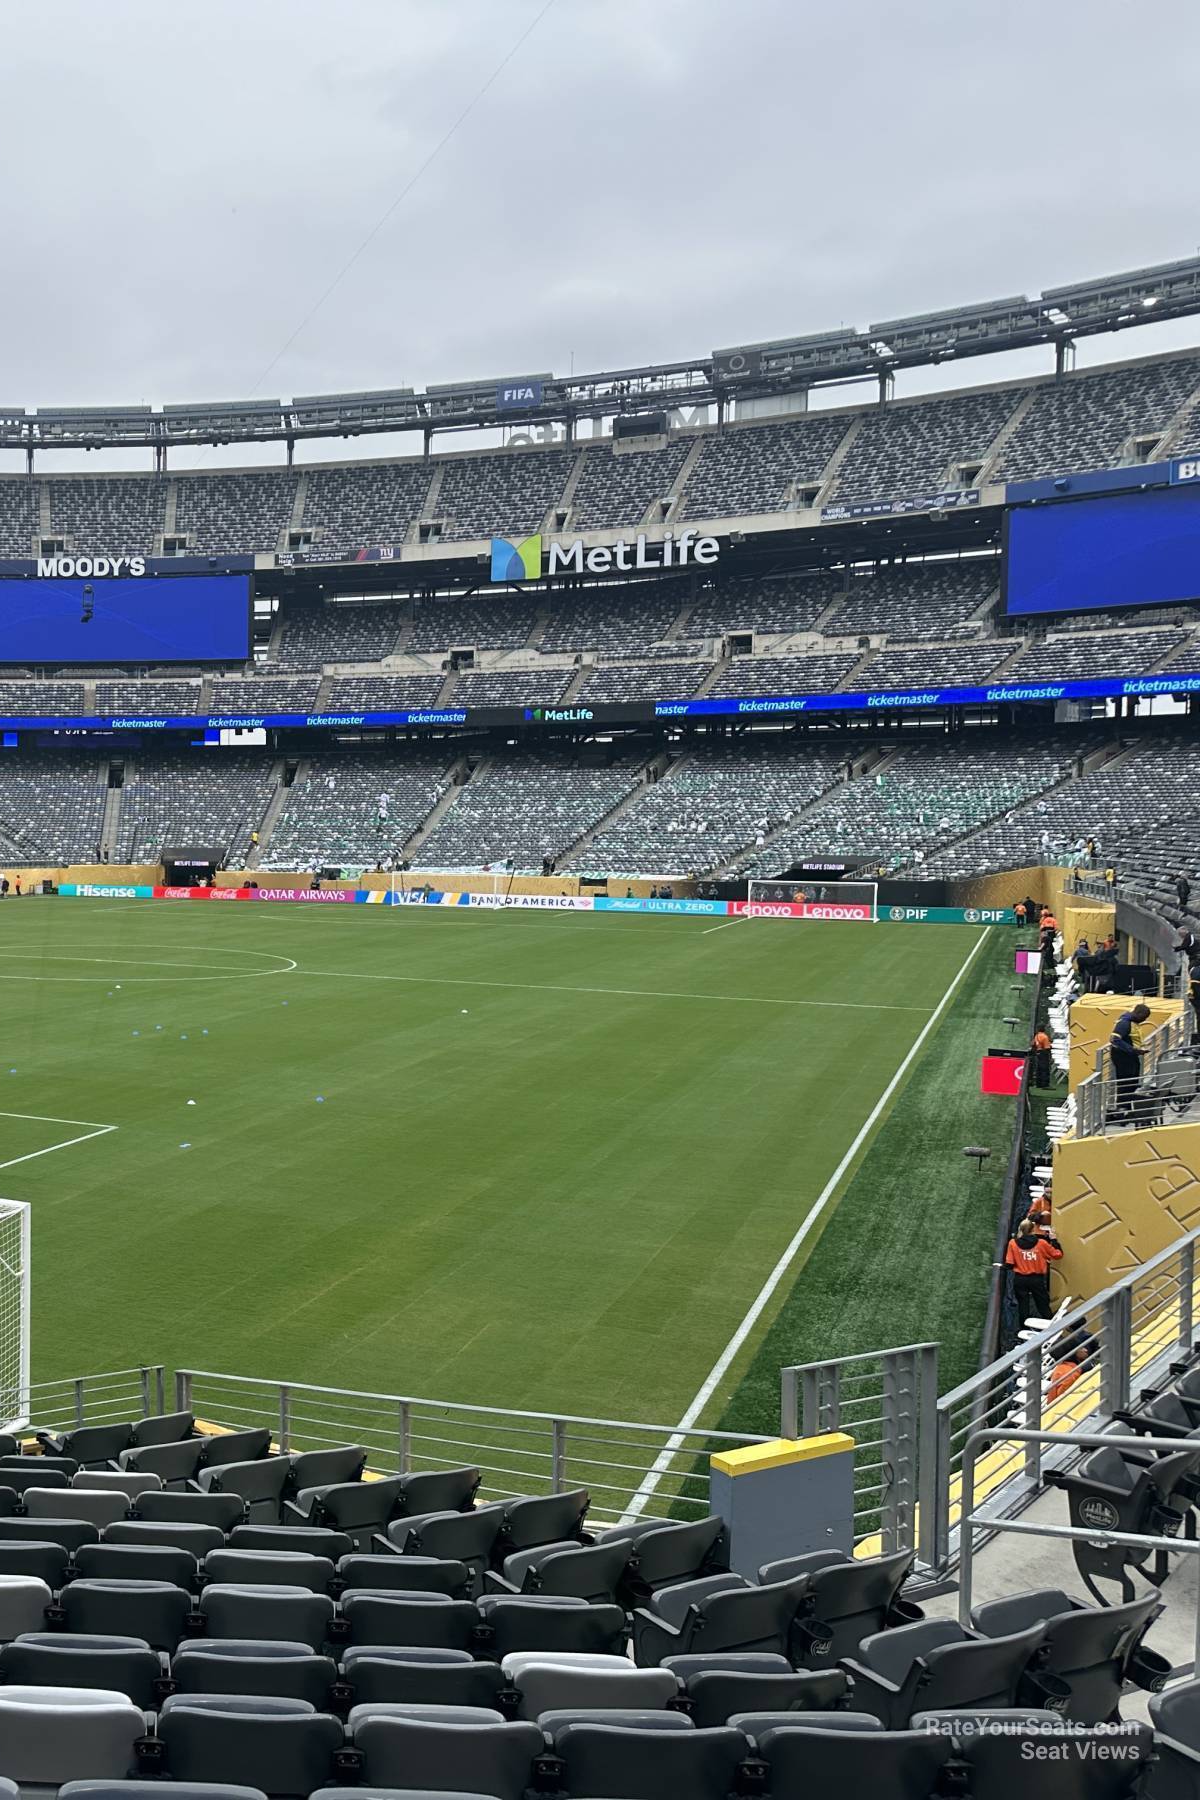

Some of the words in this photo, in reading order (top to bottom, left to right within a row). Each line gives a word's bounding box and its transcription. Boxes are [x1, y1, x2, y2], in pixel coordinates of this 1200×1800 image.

[504, 388, 534, 400] FIFA
[549, 528, 720, 575] MetLife
[37, 557, 145, 577] MOODY'S
[867, 692, 940, 706] ticketmaster
[986, 686, 1064, 700] ticketmaster
[738, 699, 806, 711] ticketmaster
[306, 715, 364, 726] ticketmaster
[544, 709, 594, 721] MetLife
[111, 719, 167, 728] ticketmaster
[208, 717, 264, 727] ticketmaster
[76, 885, 136, 898] Hisense
[259, 889, 294, 900] QATAR
[299, 889, 345, 900] AIRWAYS
[471, 895, 502, 905] BANK
[505, 897, 519, 905] OF
[522, 897, 575, 907] AMERICA
[649, 902, 681, 910] ULTRA
[685, 902, 714, 912] ZERO
[733, 903, 792, 917] Lenovo
[802, 904, 864, 918] Lenovo
[906, 909, 928, 920] PIF
[981, 910, 1004, 921] PIF
